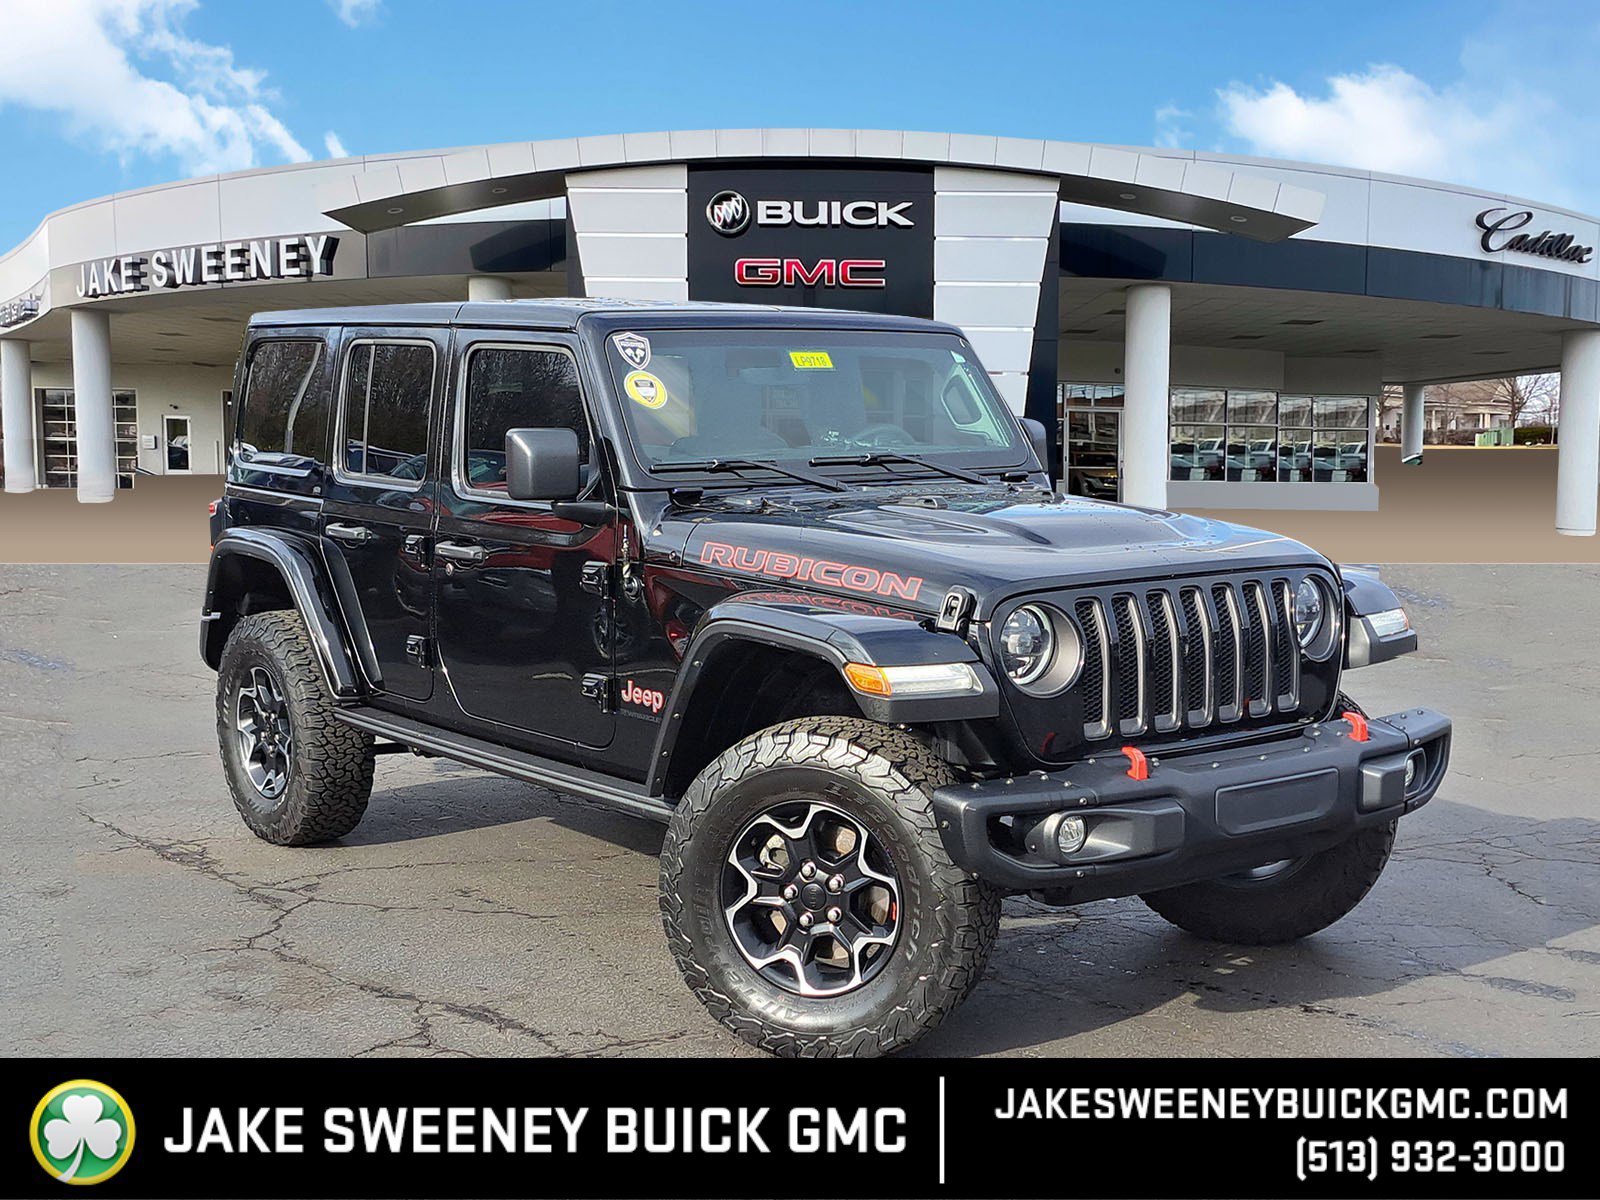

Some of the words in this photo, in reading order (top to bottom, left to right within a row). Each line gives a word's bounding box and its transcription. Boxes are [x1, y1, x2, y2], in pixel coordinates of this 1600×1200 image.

[757, 200, 915, 226] BUICK
[1475, 207, 1594, 264] Cadillac
[76, 256, 136, 298] JAKE
[152, 234, 331, 288] SWEENEY
[734, 258, 886, 287] GMC
[699, 541, 923, 601] RUBICON
[620, 679, 664, 714] Jeep
